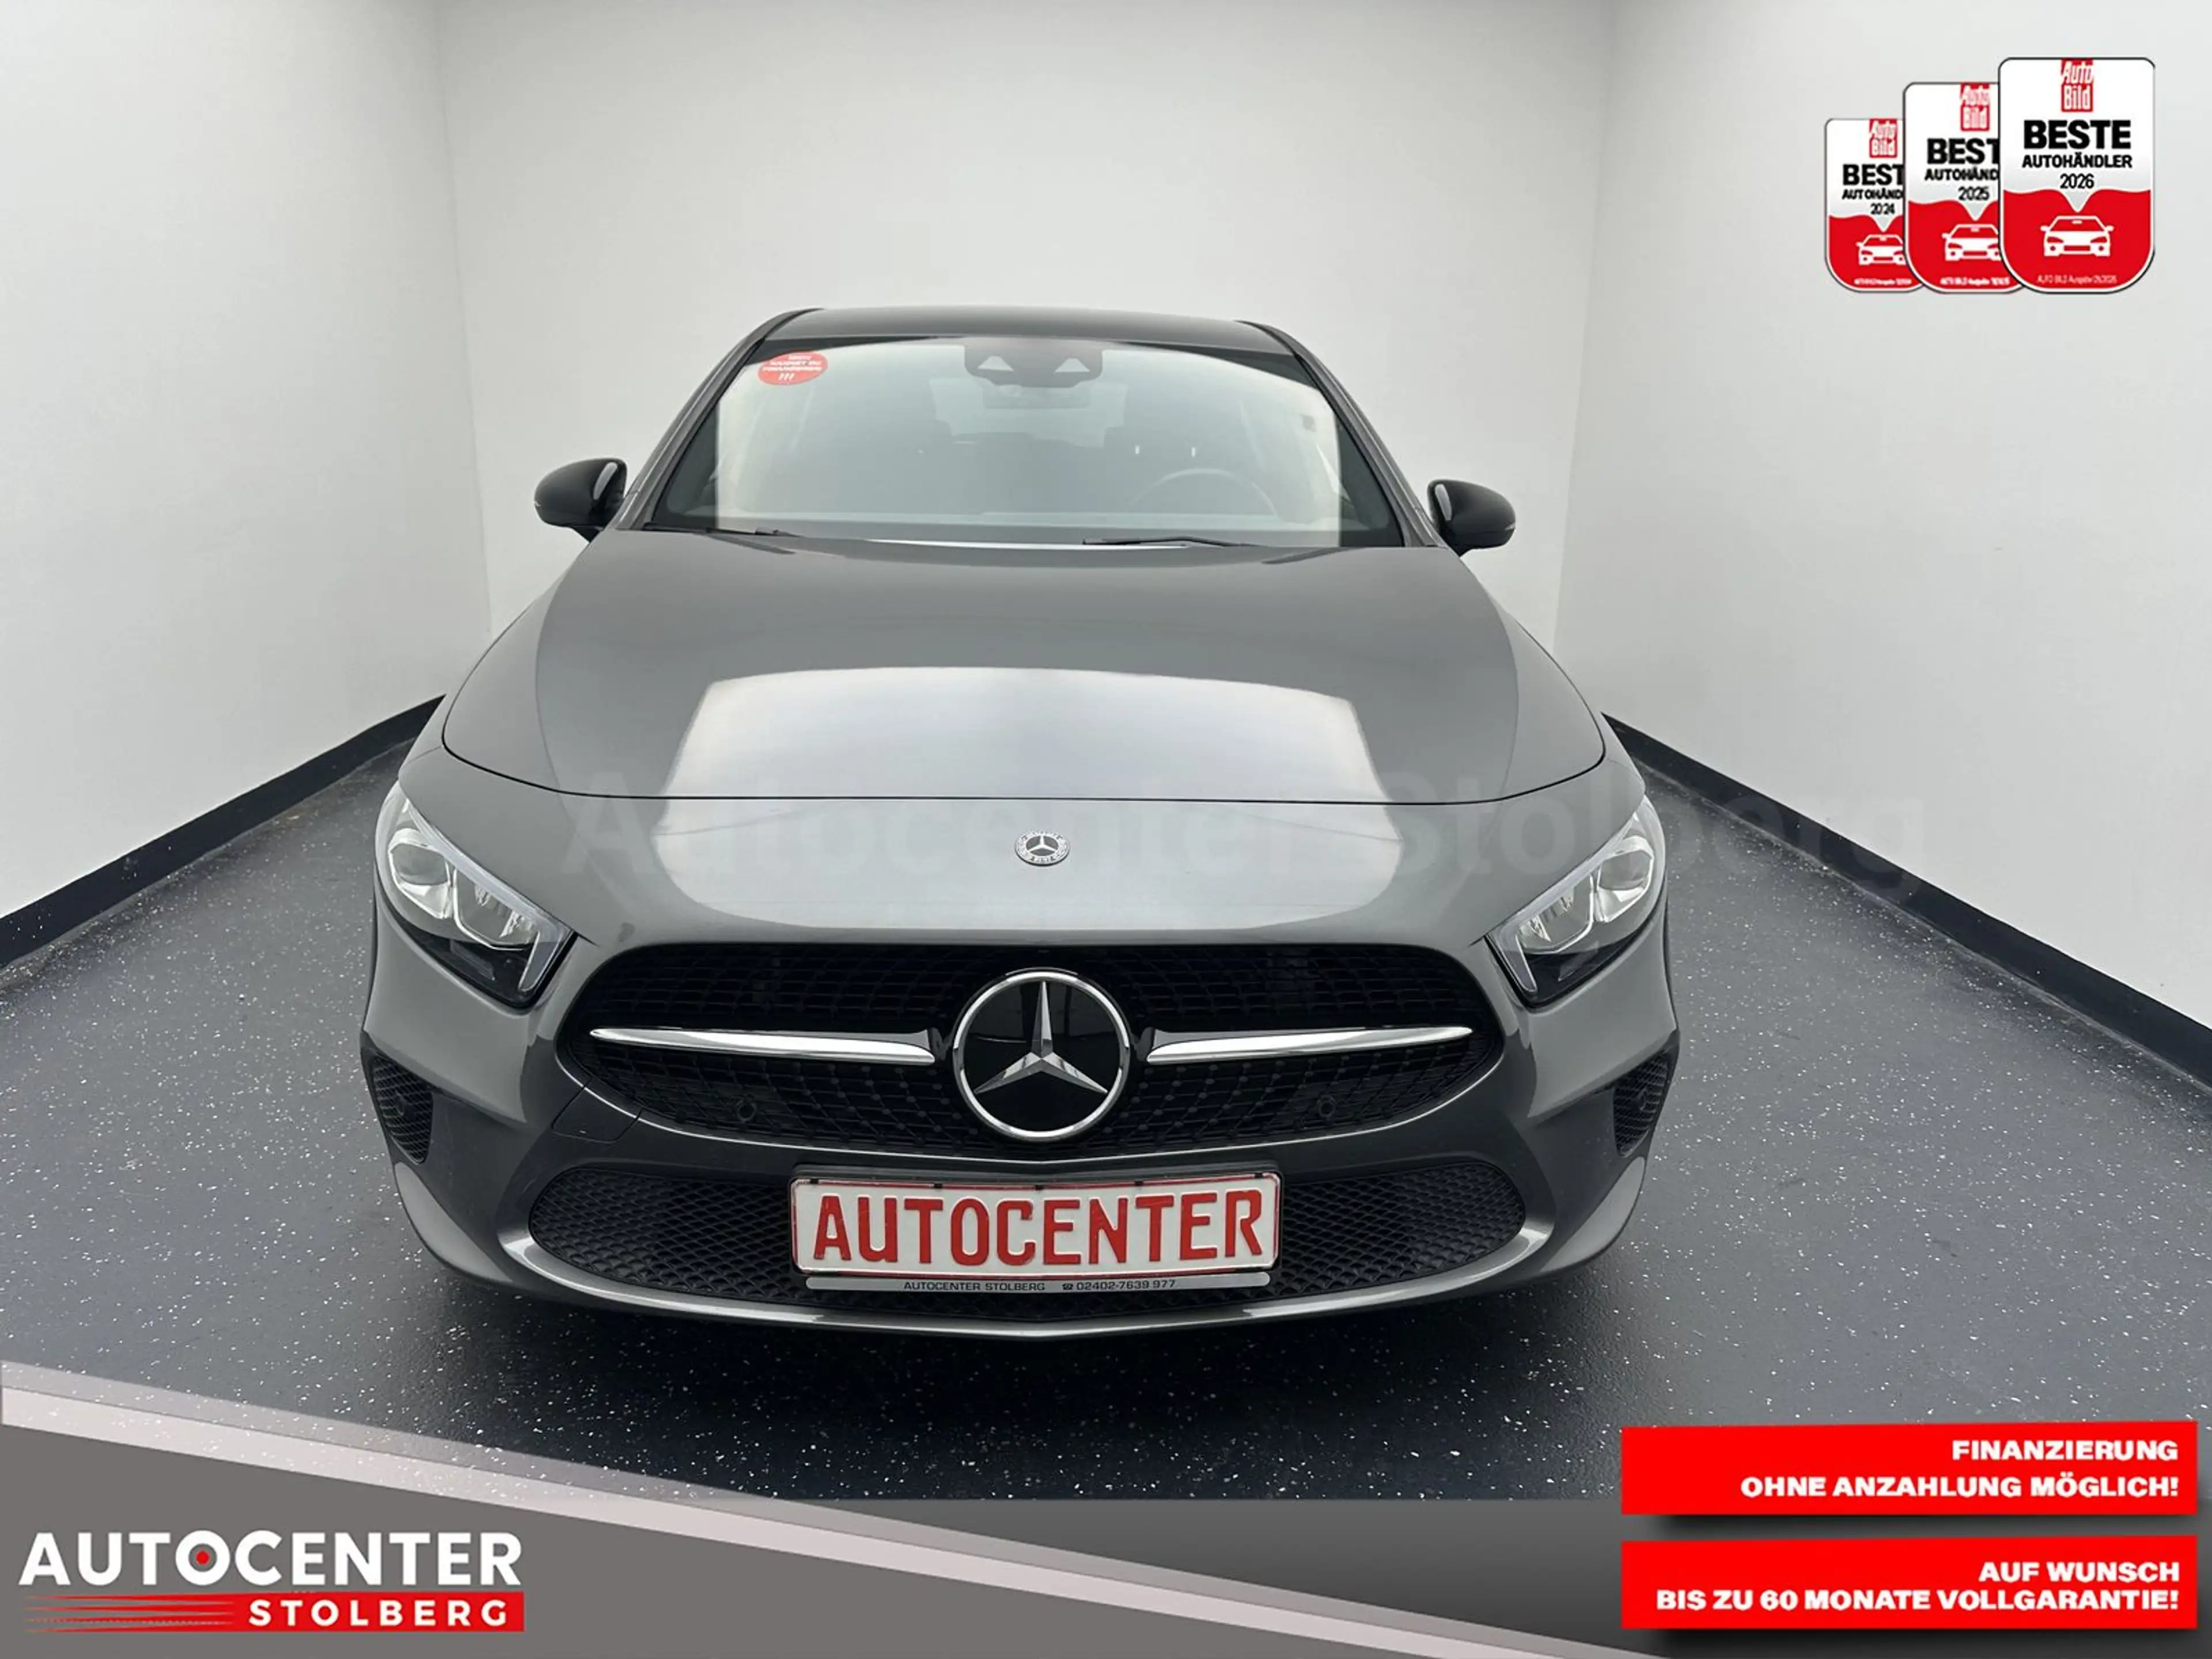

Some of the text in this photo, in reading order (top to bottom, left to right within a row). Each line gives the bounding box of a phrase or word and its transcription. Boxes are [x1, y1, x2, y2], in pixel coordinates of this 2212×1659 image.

[813, 1189, 1263, 1265] AUTOCENTER
[903, 1281, 980, 1291] AUTOCENTER
[985, 1282, 1046, 1291] STOLBERG
[1152, 1279, 1177, 1289] 977
